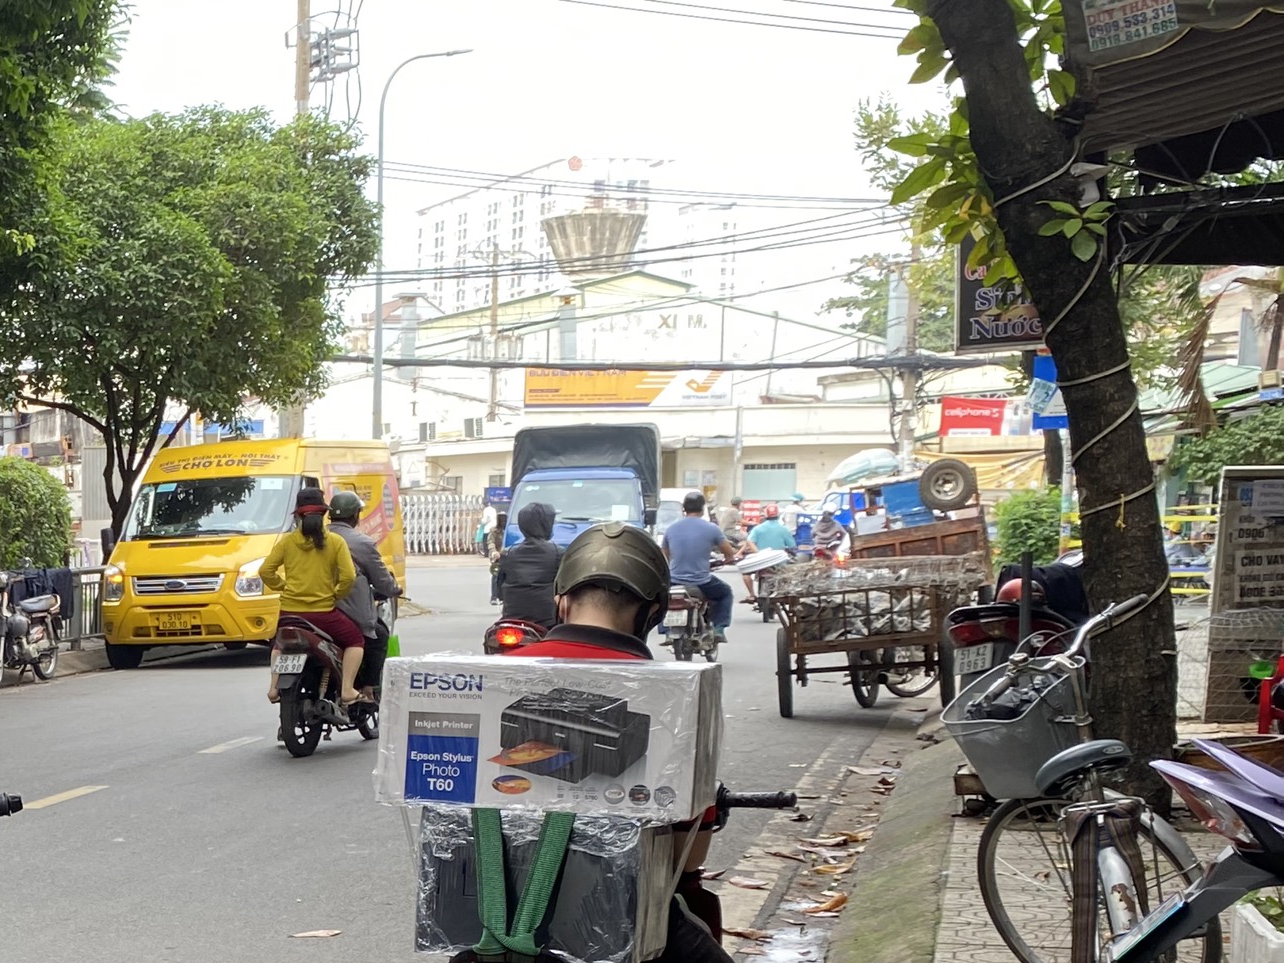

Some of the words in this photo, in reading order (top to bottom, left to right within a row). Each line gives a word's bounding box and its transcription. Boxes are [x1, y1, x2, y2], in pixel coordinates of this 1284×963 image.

[959, 656, 986, 673] 0963
[409, 672, 484, 692] EPSON
[409, 691, 437, 699] EXCEED
[414, 719, 440, 729] Inkjet
[442, 720, 474, 729] Printer
[410, 750, 441, 762] Epson
[442, 752, 473, 763] Stylus
[422, 762, 461, 777] Photo
[427, 777, 454, 792] T60
